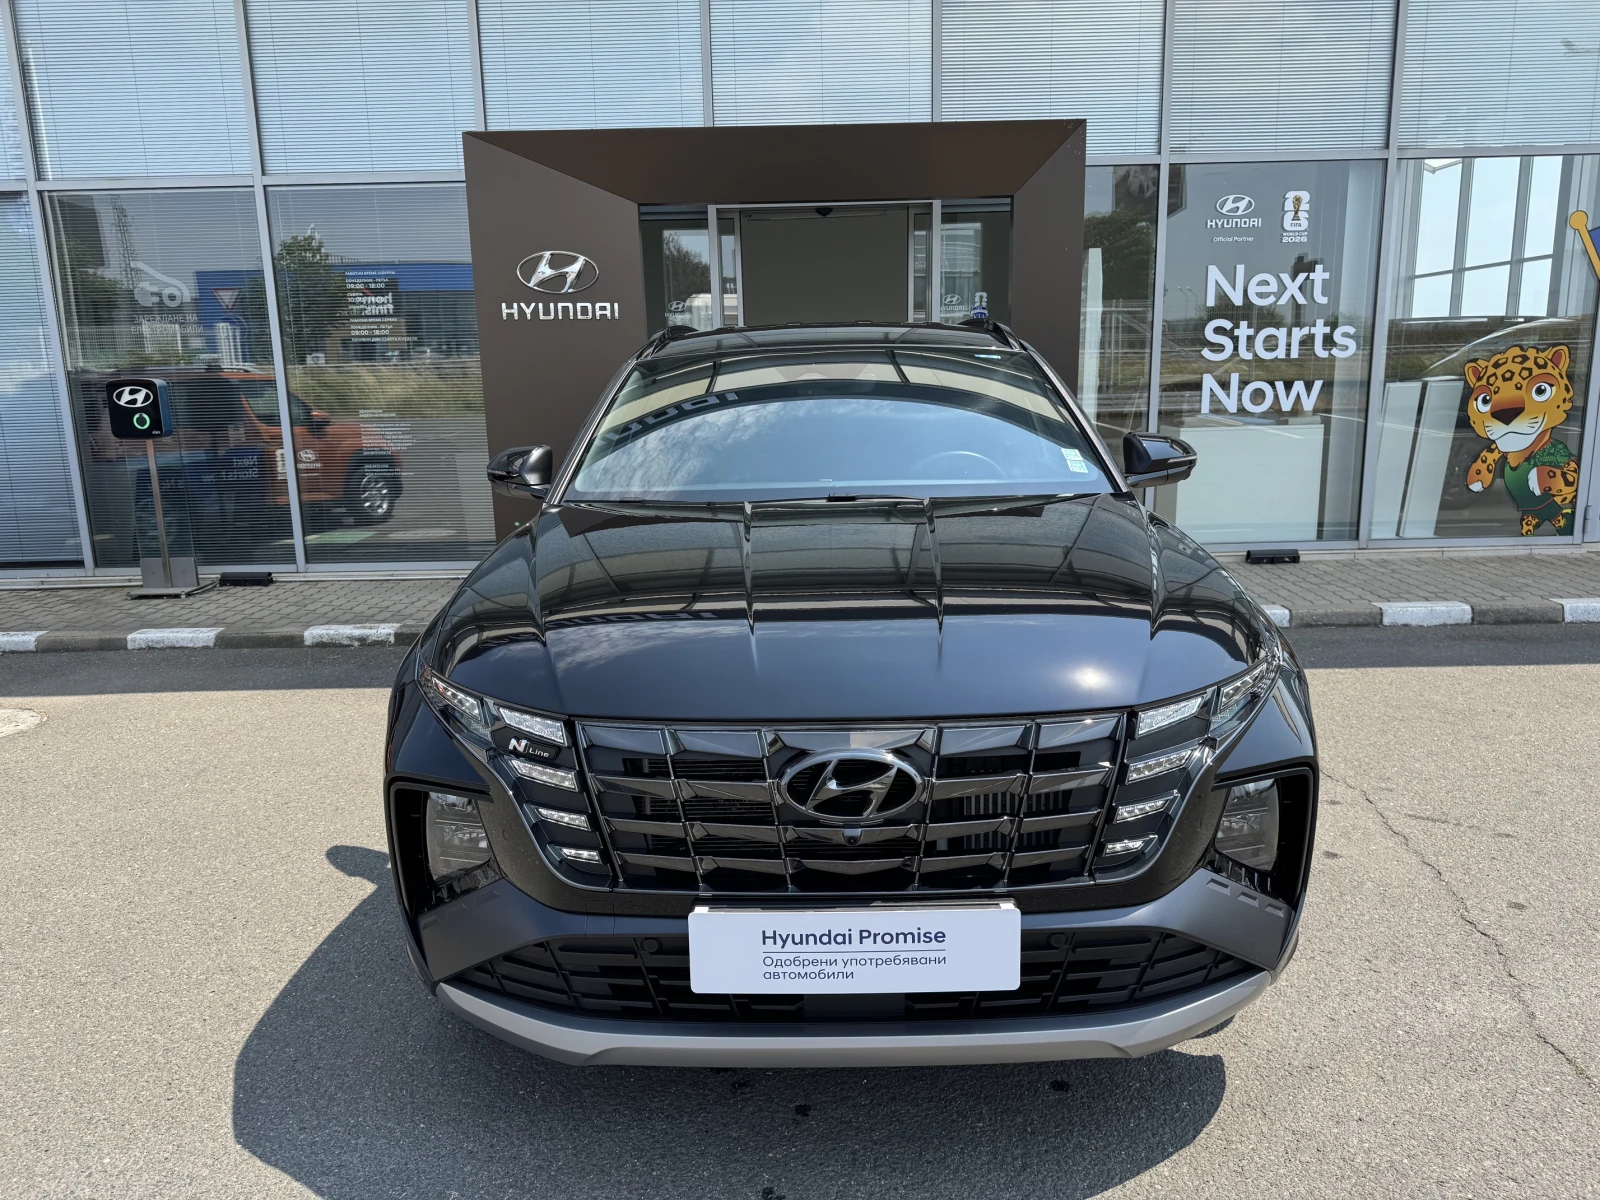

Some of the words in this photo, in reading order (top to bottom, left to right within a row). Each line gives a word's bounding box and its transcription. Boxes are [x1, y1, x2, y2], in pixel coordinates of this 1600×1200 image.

[1207, 218, 1262, 228] HYUNDAI
[1206, 264, 1330, 307] Next
[501, 302, 619, 320] HYUNDAI
[1200, 318, 1357, 362] Starts
[1200, 372, 1324, 414] Now
[508, 738, 528, 752] N
[529, 748, 549, 757] Line
[762, 928, 853, 949] Hyundai
[858, 927, 947, 945] Promise
[762, 956, 838, 969] Одобрени
[841, 954, 947, 969] употребявани
[763, 968, 854, 980] автомобили
